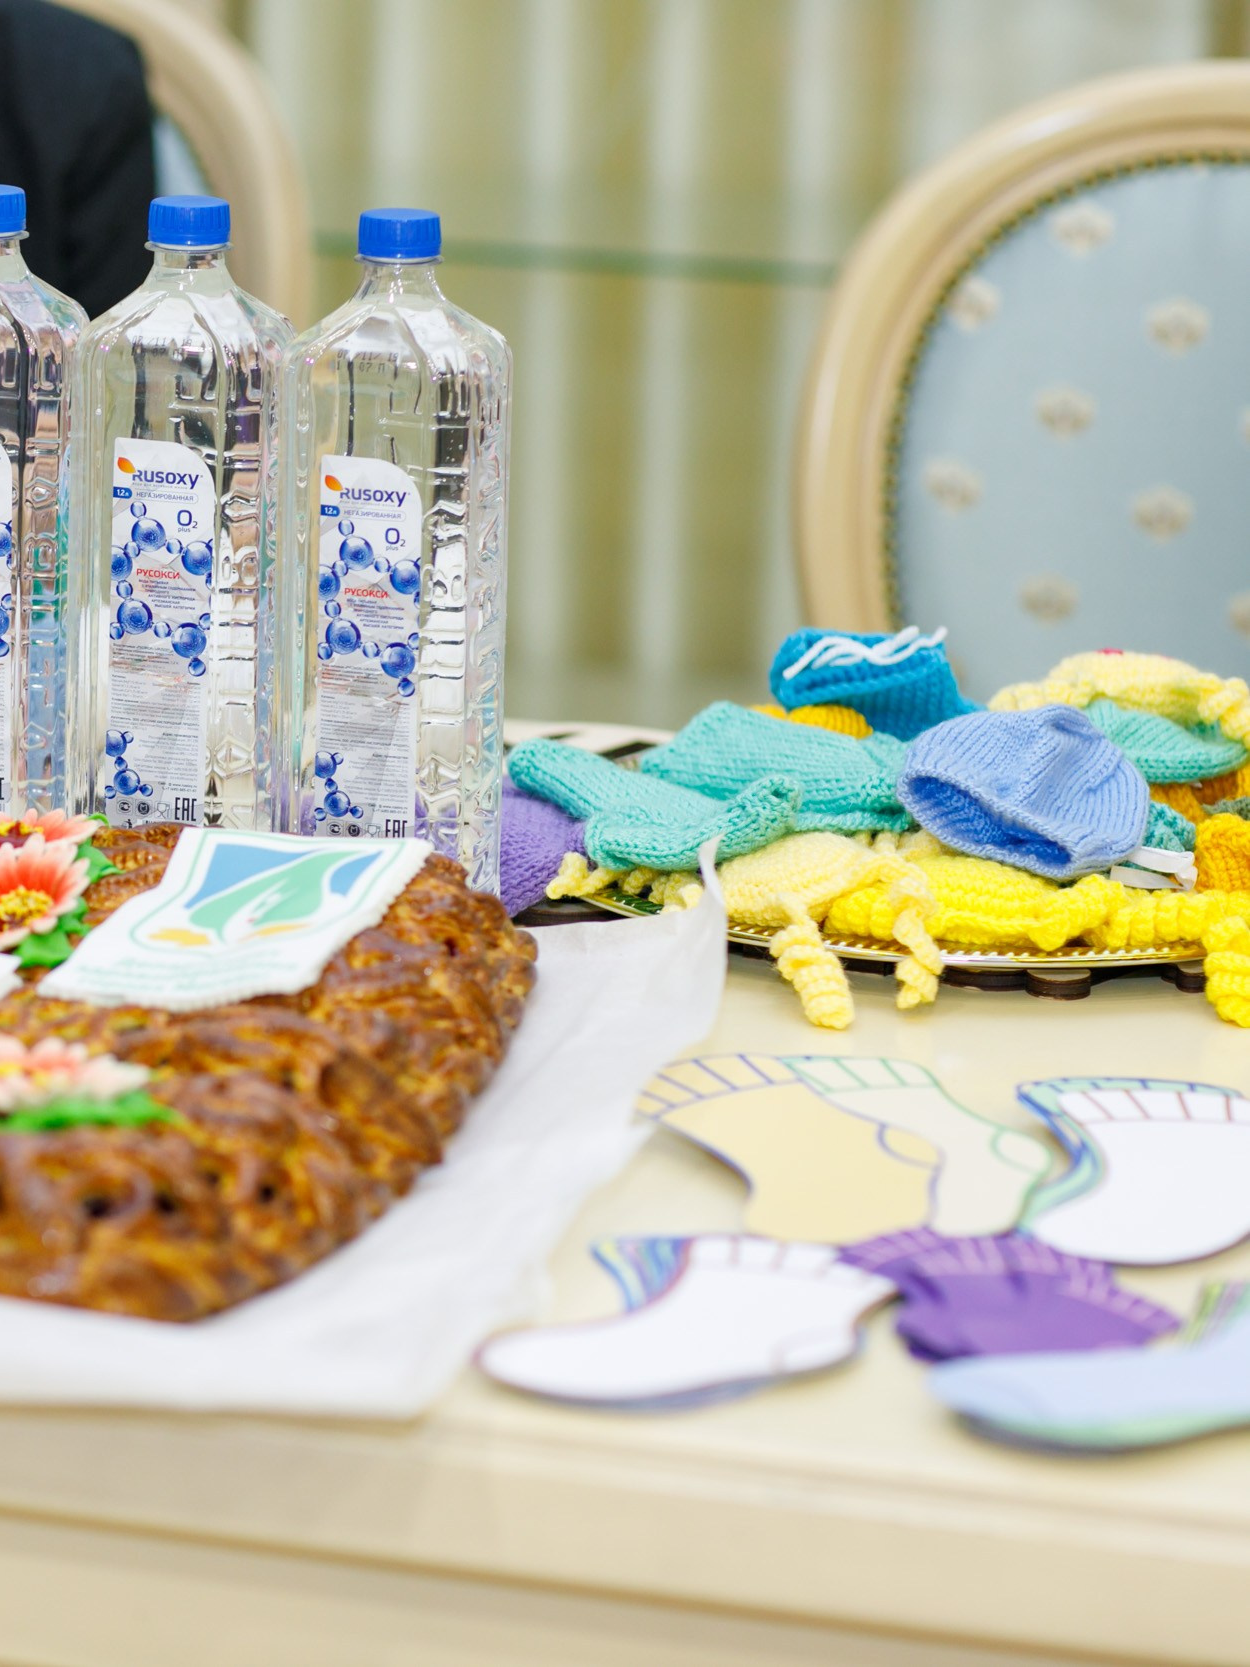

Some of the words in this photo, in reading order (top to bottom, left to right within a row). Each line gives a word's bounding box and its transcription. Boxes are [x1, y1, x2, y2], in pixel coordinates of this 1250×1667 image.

[136, 491, 194, 502] НЕГАЗИРОВАННАЯ
[344, 509, 402, 520] НЕГАЗИРОВАННАЯ
[136, 568, 181, 580] РУСОКСИ
[344, 587, 391, 599] РУСОКСИ
[174, 797, 197, 822] EAC
